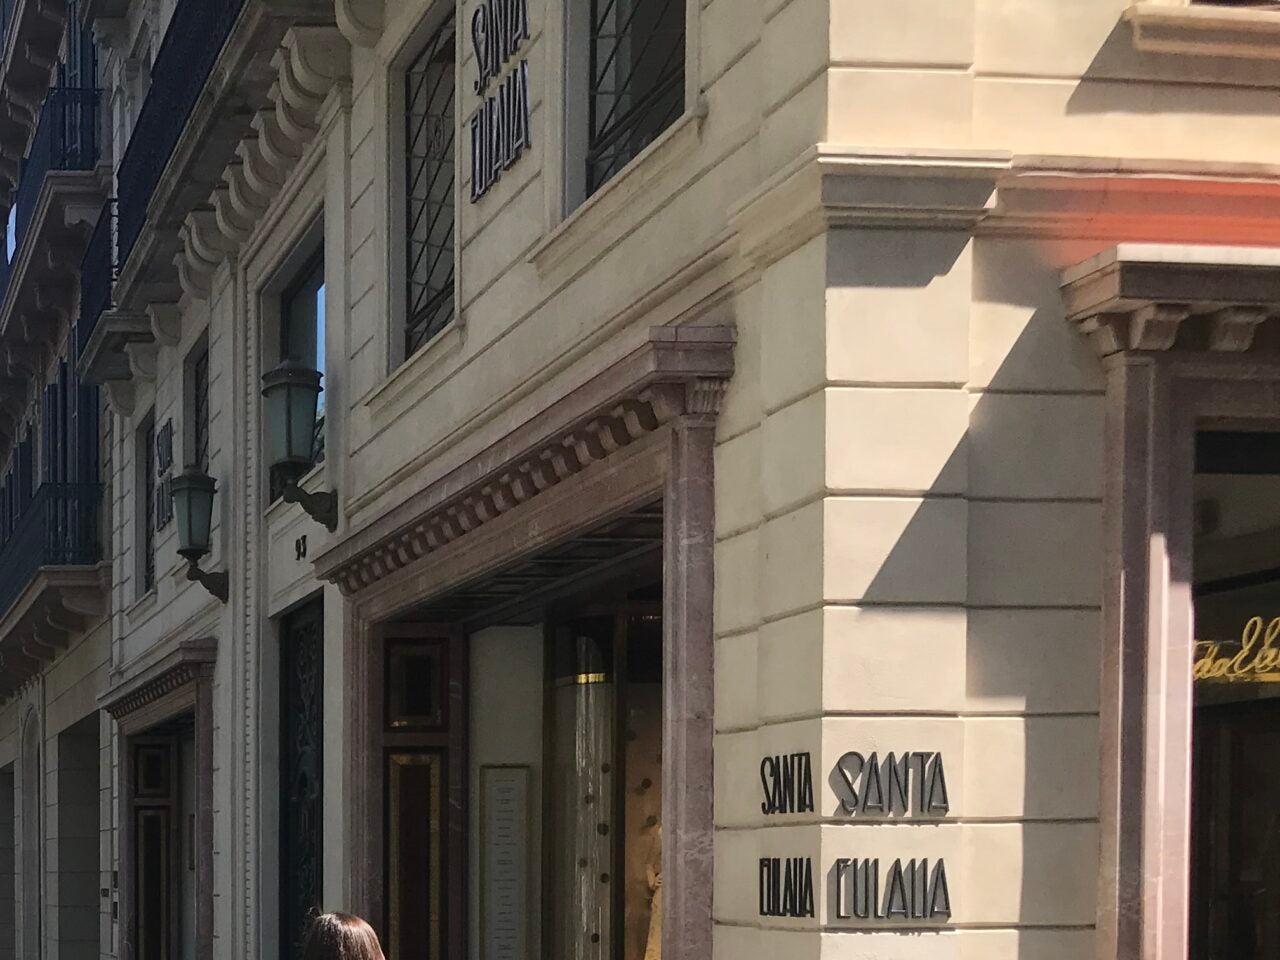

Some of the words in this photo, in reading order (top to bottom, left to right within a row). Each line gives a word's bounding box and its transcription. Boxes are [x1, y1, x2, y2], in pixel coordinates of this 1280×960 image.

[760, 752, 814, 815] SANTA
[837, 751, 950, 814] SANTA
[759, 857, 815, 918] EULALIA
[836, 857, 952, 919] EULALIA
